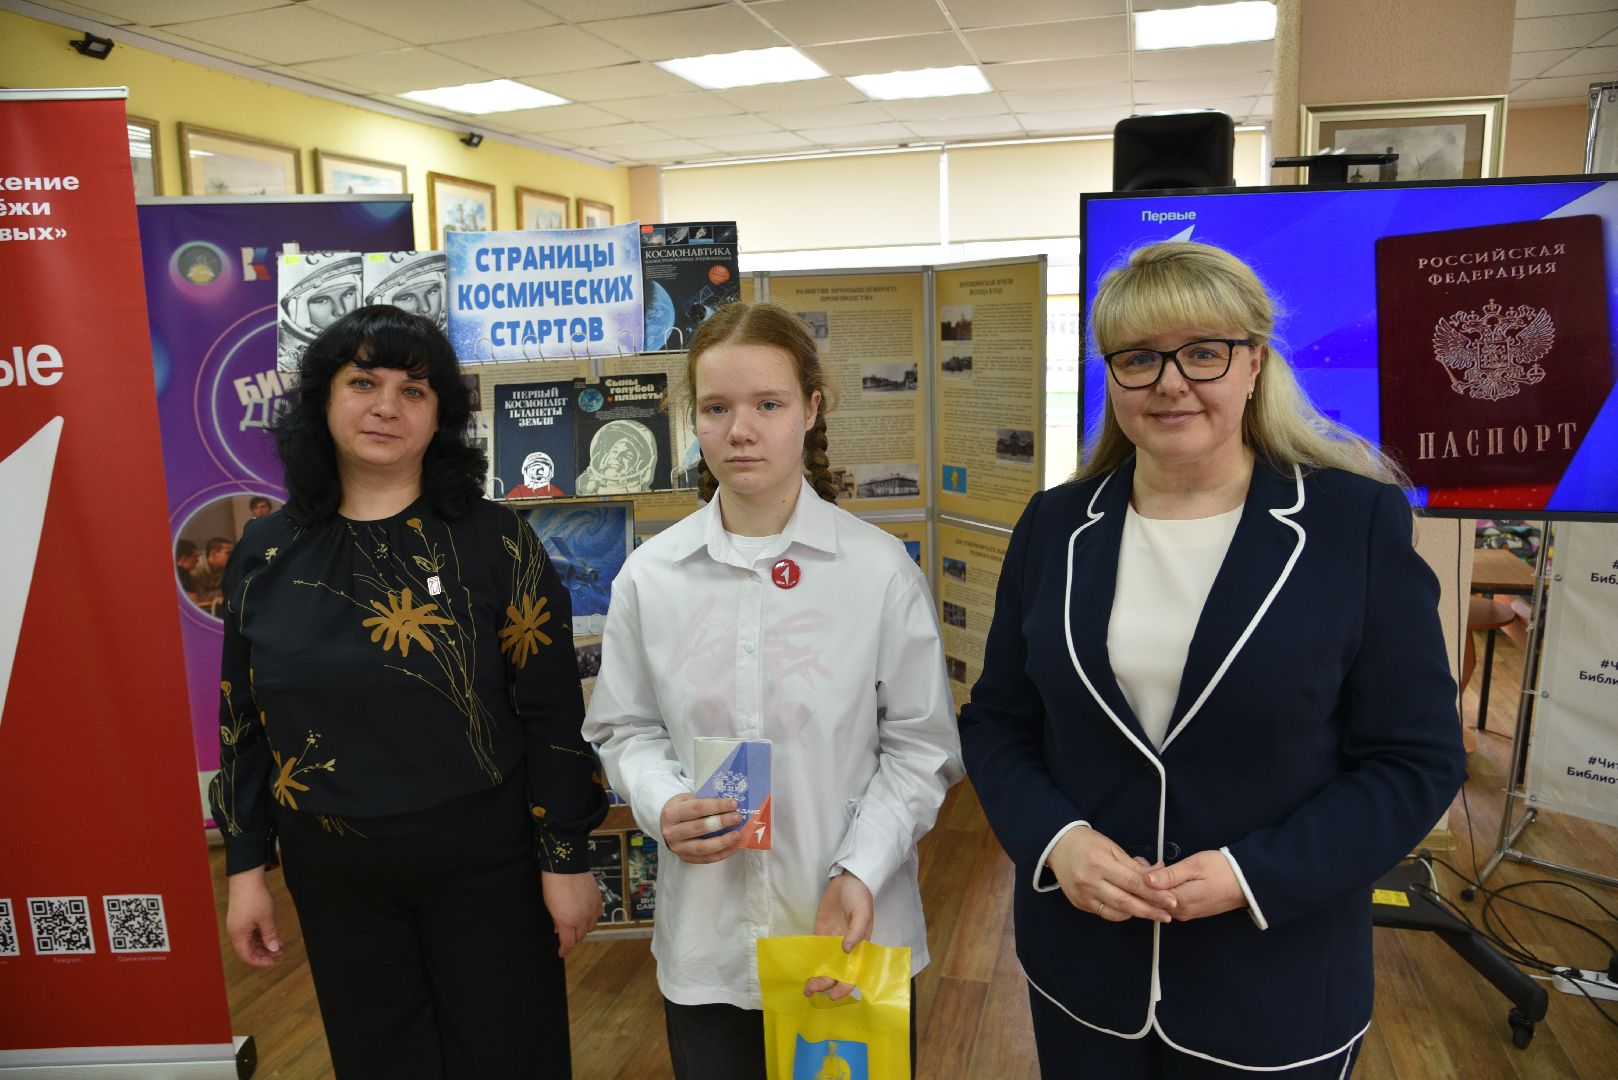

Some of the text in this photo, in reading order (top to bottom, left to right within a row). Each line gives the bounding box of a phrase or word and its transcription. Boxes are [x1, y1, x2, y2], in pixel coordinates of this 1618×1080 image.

[0, 175, 80, 191] ение
[1141, 210, 1197, 225] Первые
[475, 242, 615, 274] СТРАНИЦЫ
[645, 247, 732, 259] КОСМОНАВТИКА
[1417, 243, 1567, 269] РОССИЙСКАЯ
[1427, 262, 1558, 286] ФЕДЕРАЦИЯ
[457, 274, 634, 311] КОСМИЧЕСКИХ
[490, 316, 605, 347] СТАРТОВ
[605, 378, 639, 387] Сыны
[610, 383, 655, 395] голубой
[512, 386, 560, 400] ПЕРВЫЙ
[614, 391, 664, 402] планеты
[504, 397, 569, 410] КОСМОНАВТ
[509, 406, 563, 419] ПЛАНЕТЫ
[518, 416, 555, 427] ЗЕМЛЯ
[1417, 422, 1578, 460] ПАСПОРТ
